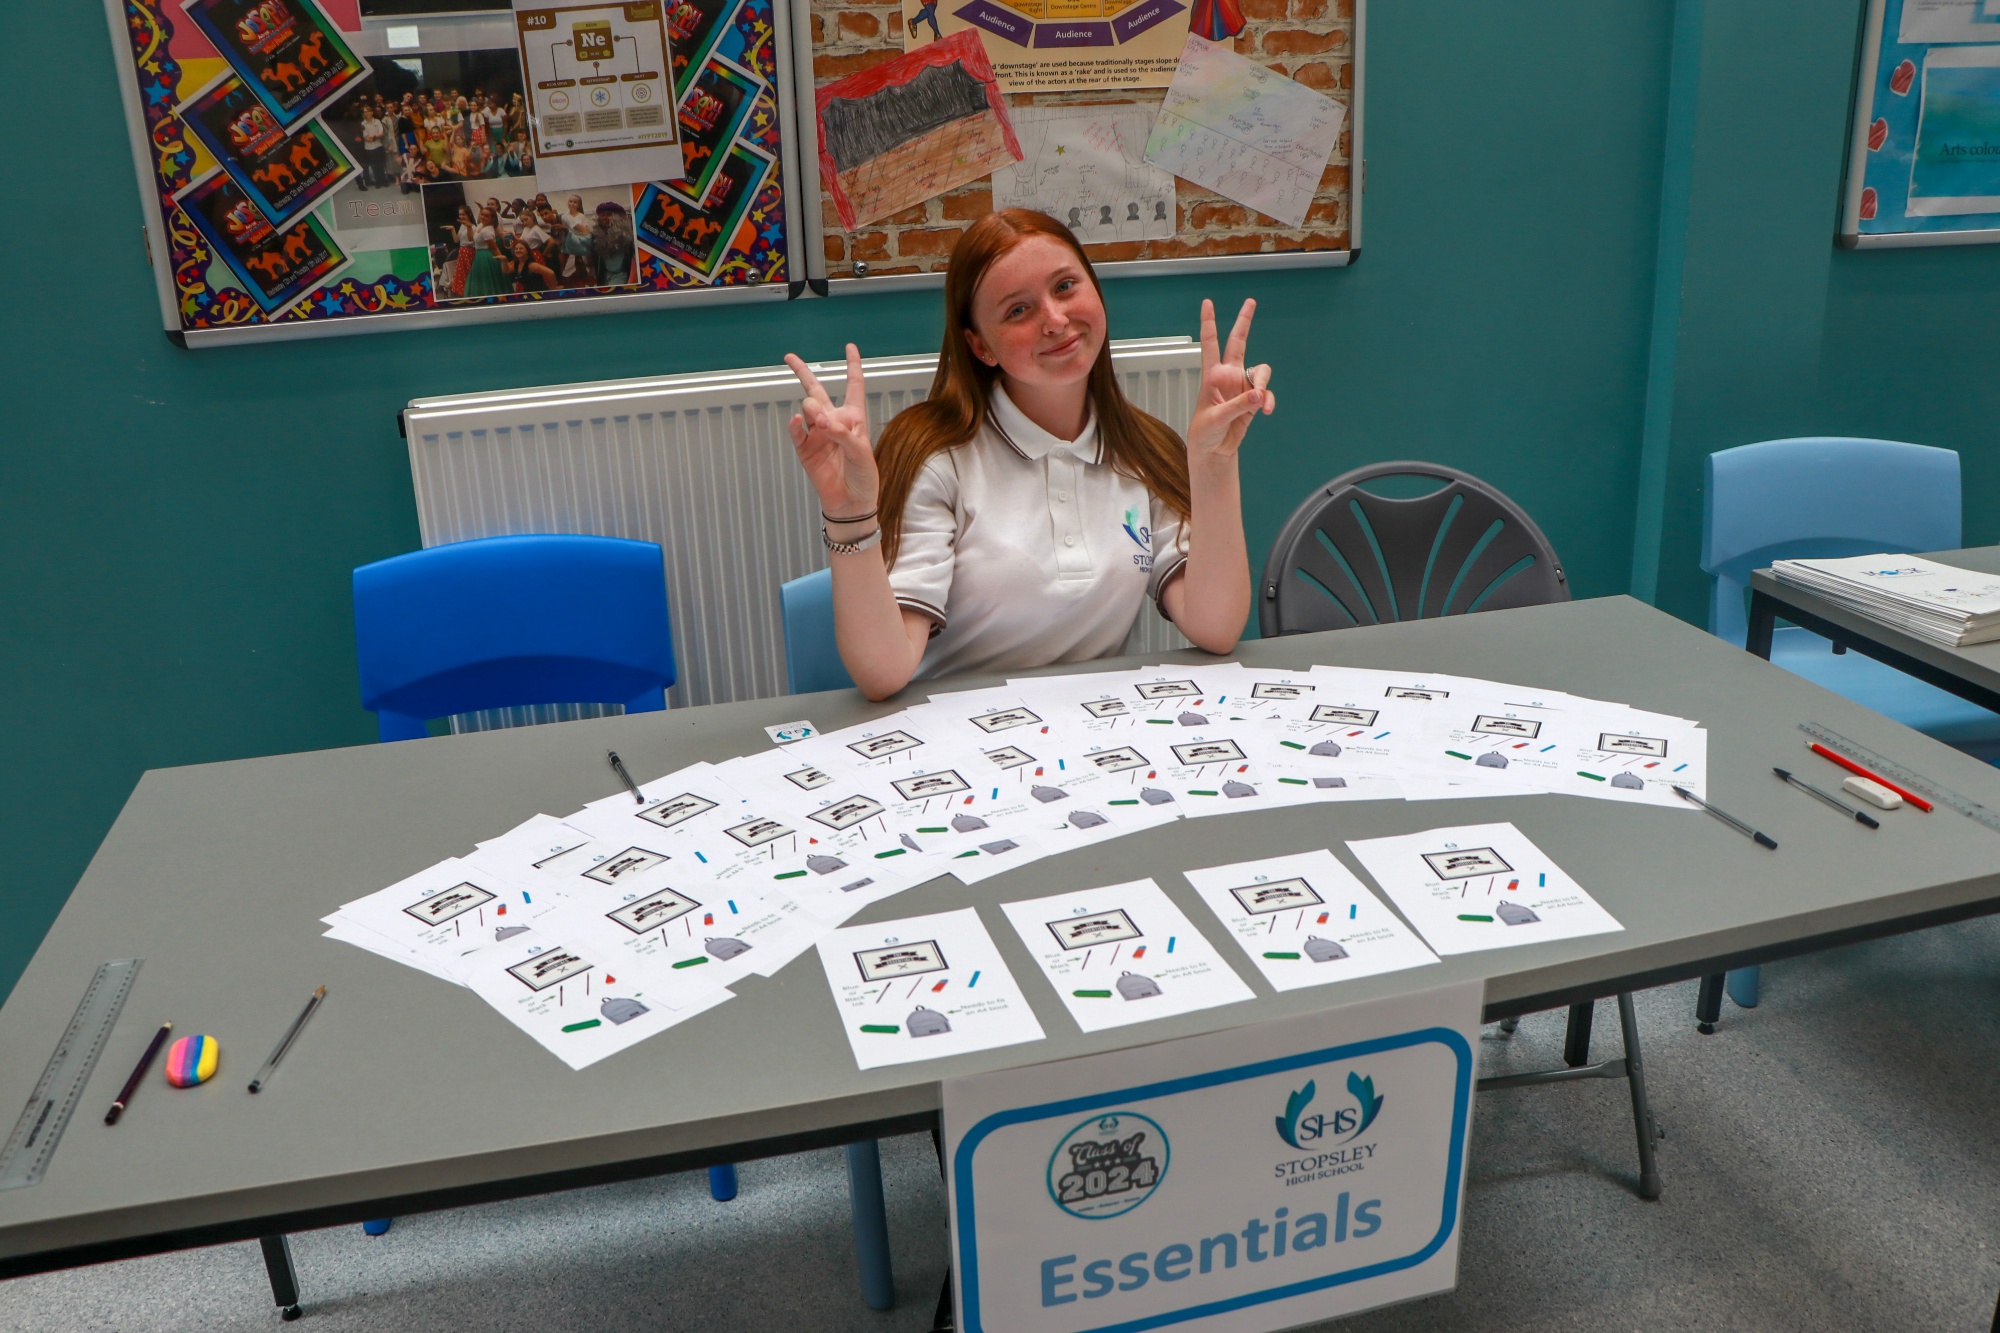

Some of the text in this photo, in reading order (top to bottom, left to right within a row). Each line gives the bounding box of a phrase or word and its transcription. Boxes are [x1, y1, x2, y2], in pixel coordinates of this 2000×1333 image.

[527, 15, 547, 26] #10
[979, 11, 1016, 33] Audience
[1127, 6, 1161, 30] Audience
[580, 32, 606, 48] Ne
[1055, 30, 1093, 39] Audience
[1015, 69, 1028, 77] This
[1030, 69, 1035, 77] is
[1036, 68, 1059, 77] known
[1093, 66, 1106, 74] and
[1107, 66, 1113, 74] is
[1052, 60, 1067, 68] used
[1069, 58, 1094, 67] because
[1096, 57, 1133, 68] traditionally
[1134, 58, 1154, 66] stages
[1155, 57, 1172, 66] slope
[1008, 79, 1025, 87] view
[1035, 78, 1046, 86] the
[1047, 77, 1067, 85] actors
[1076, 76, 1087, 84] the
[1122, 75, 1141, 83] stage.
[1940, 143, 1966, 155] Arts
[348, 199, 417, 218] Team
[1299, 1107, 1357, 1141] SHS
[1071, 1134, 1143, 1166] Class of
[1274, 1142, 1378, 1179] STOPSLEY
[1060, 1158, 1157, 1204] 2024
[1285, 1162, 1366, 1187] HIGH SCHOOL
[1041, 1191, 1383, 1308] Essentials
